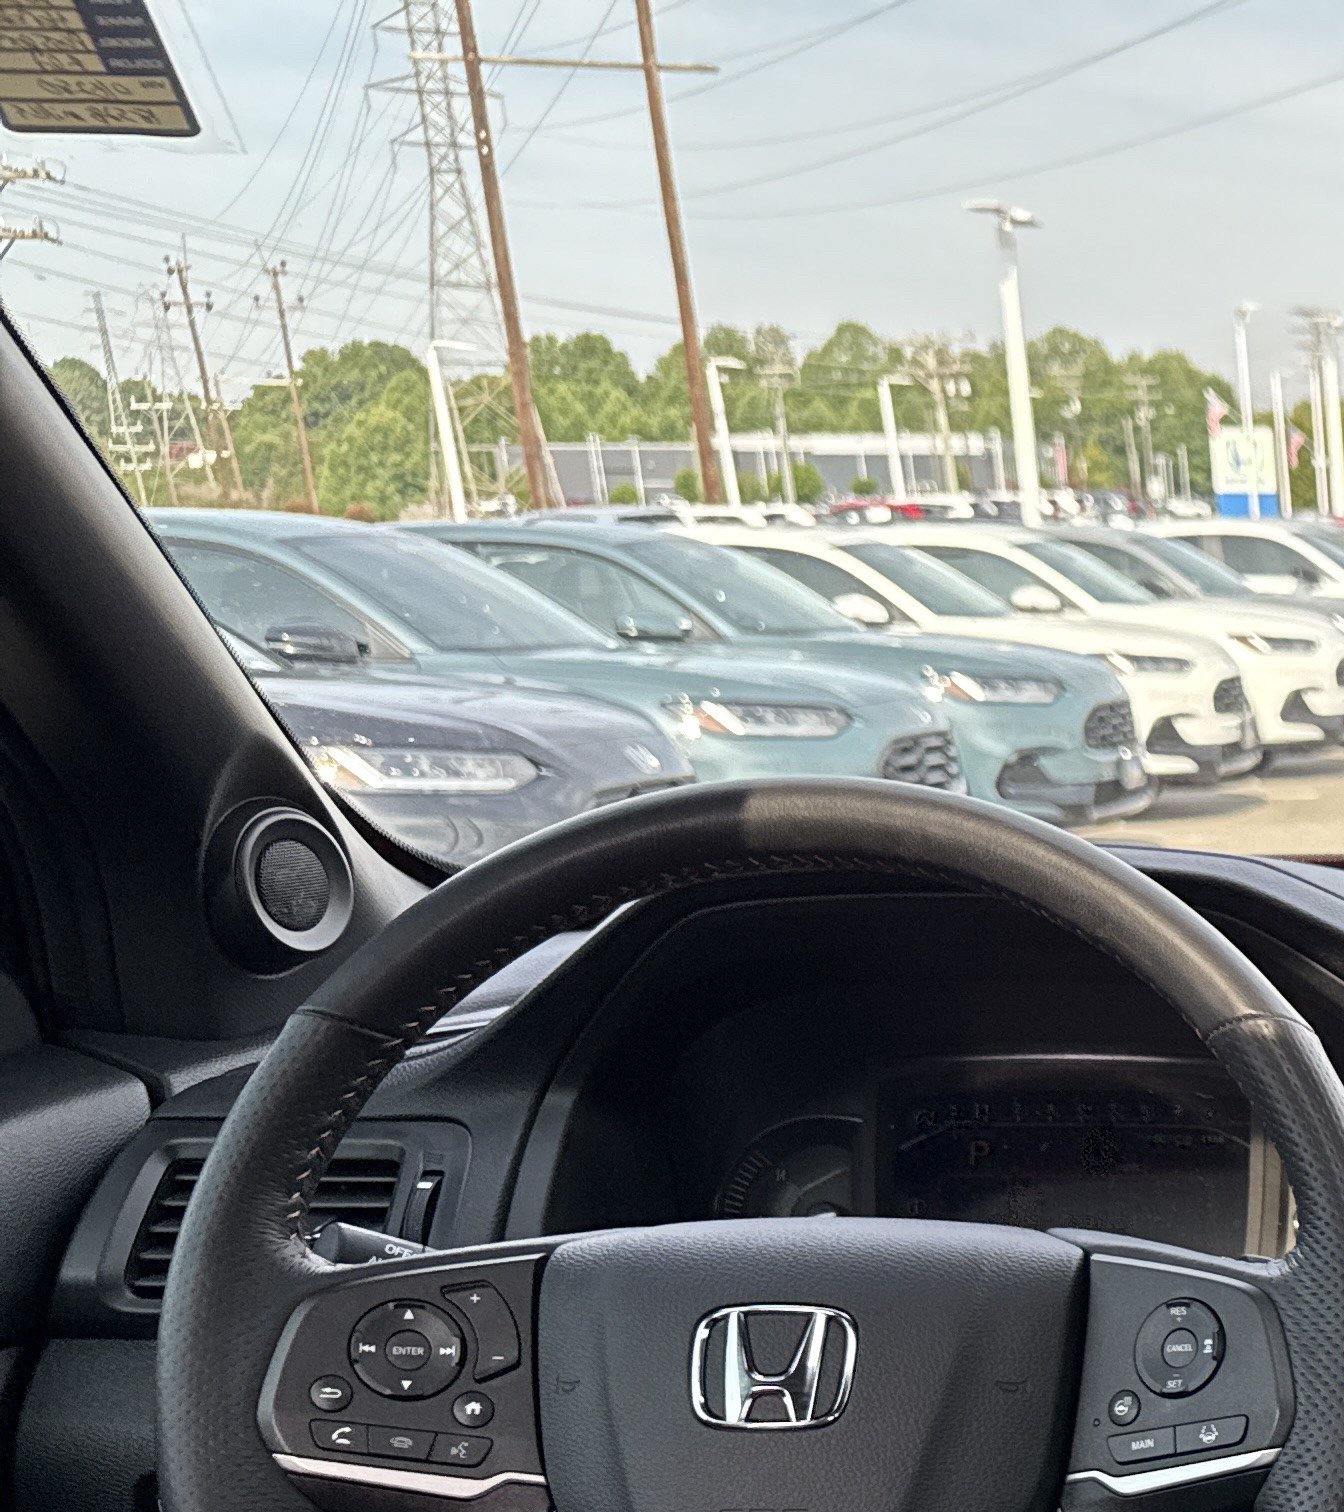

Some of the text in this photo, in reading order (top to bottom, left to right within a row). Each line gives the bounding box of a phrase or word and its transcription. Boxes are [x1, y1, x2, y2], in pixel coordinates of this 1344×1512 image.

[1169, 1307, 1187, 1316] RES
[392, 1346, 425, 1356] ENTER
[1166, 1343, 1193, 1353] CANCEL
[1165, 1379, 1184, 1389] SET
[1131, 1438, 1155, 1451] MAIN
